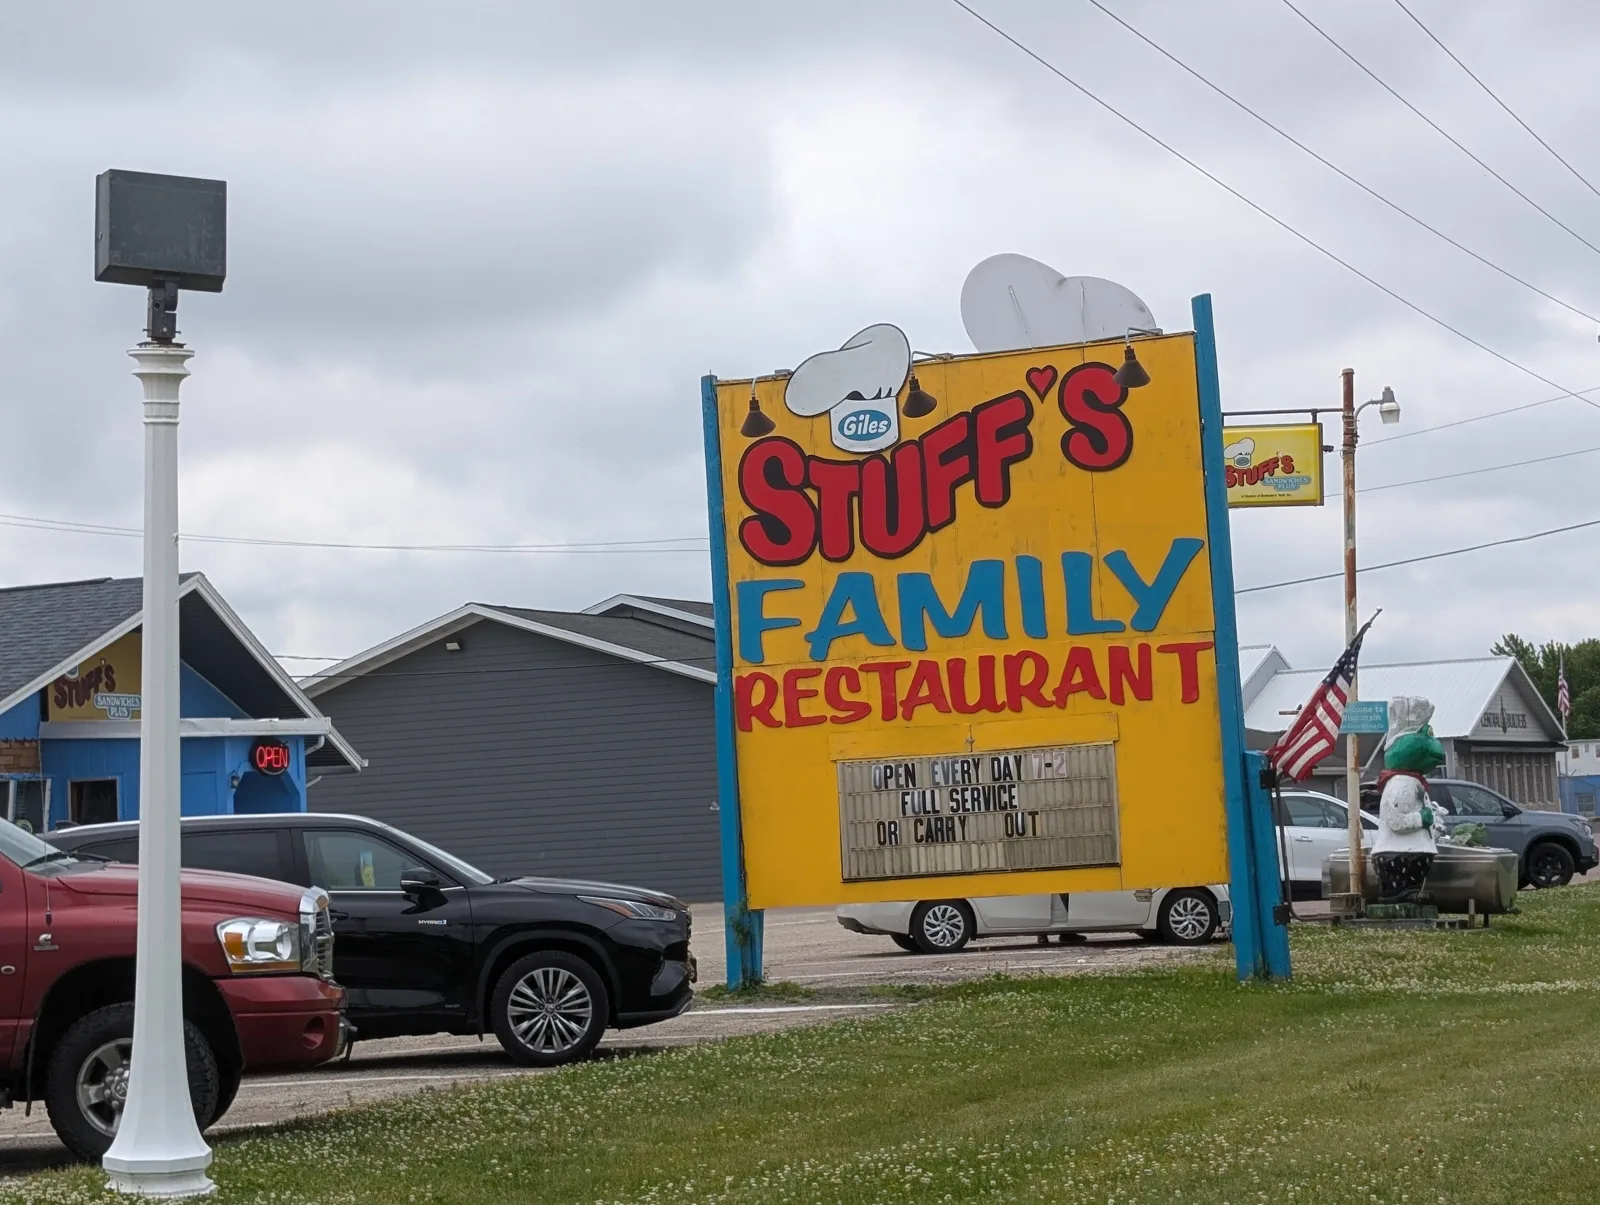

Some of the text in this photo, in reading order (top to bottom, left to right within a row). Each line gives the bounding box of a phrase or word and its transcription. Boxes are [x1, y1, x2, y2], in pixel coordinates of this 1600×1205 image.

[843, 414, 889, 436] Giles
[738, 361, 1134, 567] STUFF'S
[736, 538, 1205, 664] FAMILY
[97, 696, 140, 707] SANDWICHES
[732, 642, 1215, 732] RESTAURANT
[110, 707, 129, 717] PLUS
[1375, 705, 1384, 713] to
[256, 746, 288, 768] OPEN
[873, 752, 1066, 790] OPEN EVERY DAY 7-2
[901, 784, 1018, 816] FULL SERVICE
[876, 811, 1039, 846] OR CARRY OUT
